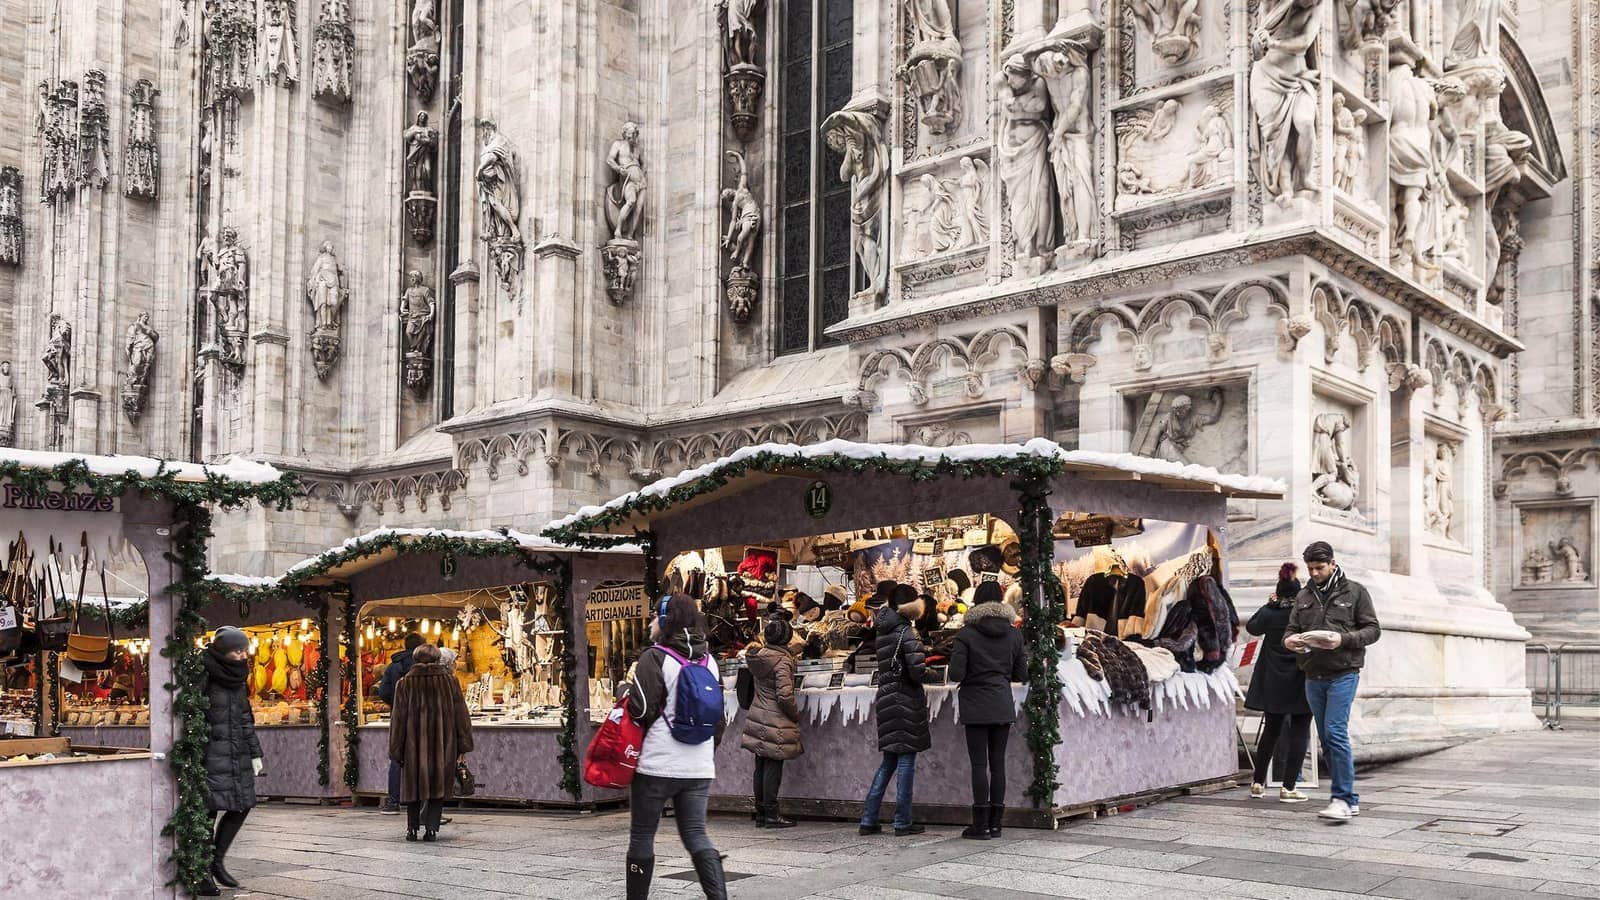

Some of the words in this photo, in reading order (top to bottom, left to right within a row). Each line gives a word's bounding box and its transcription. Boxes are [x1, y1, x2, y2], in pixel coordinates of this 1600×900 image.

[811, 487, 826, 509] 14
[443, 557, 454, 574] 15
[241, 601, 249, 615] 16
[585, 604, 642, 621] ARTIGIANALE
